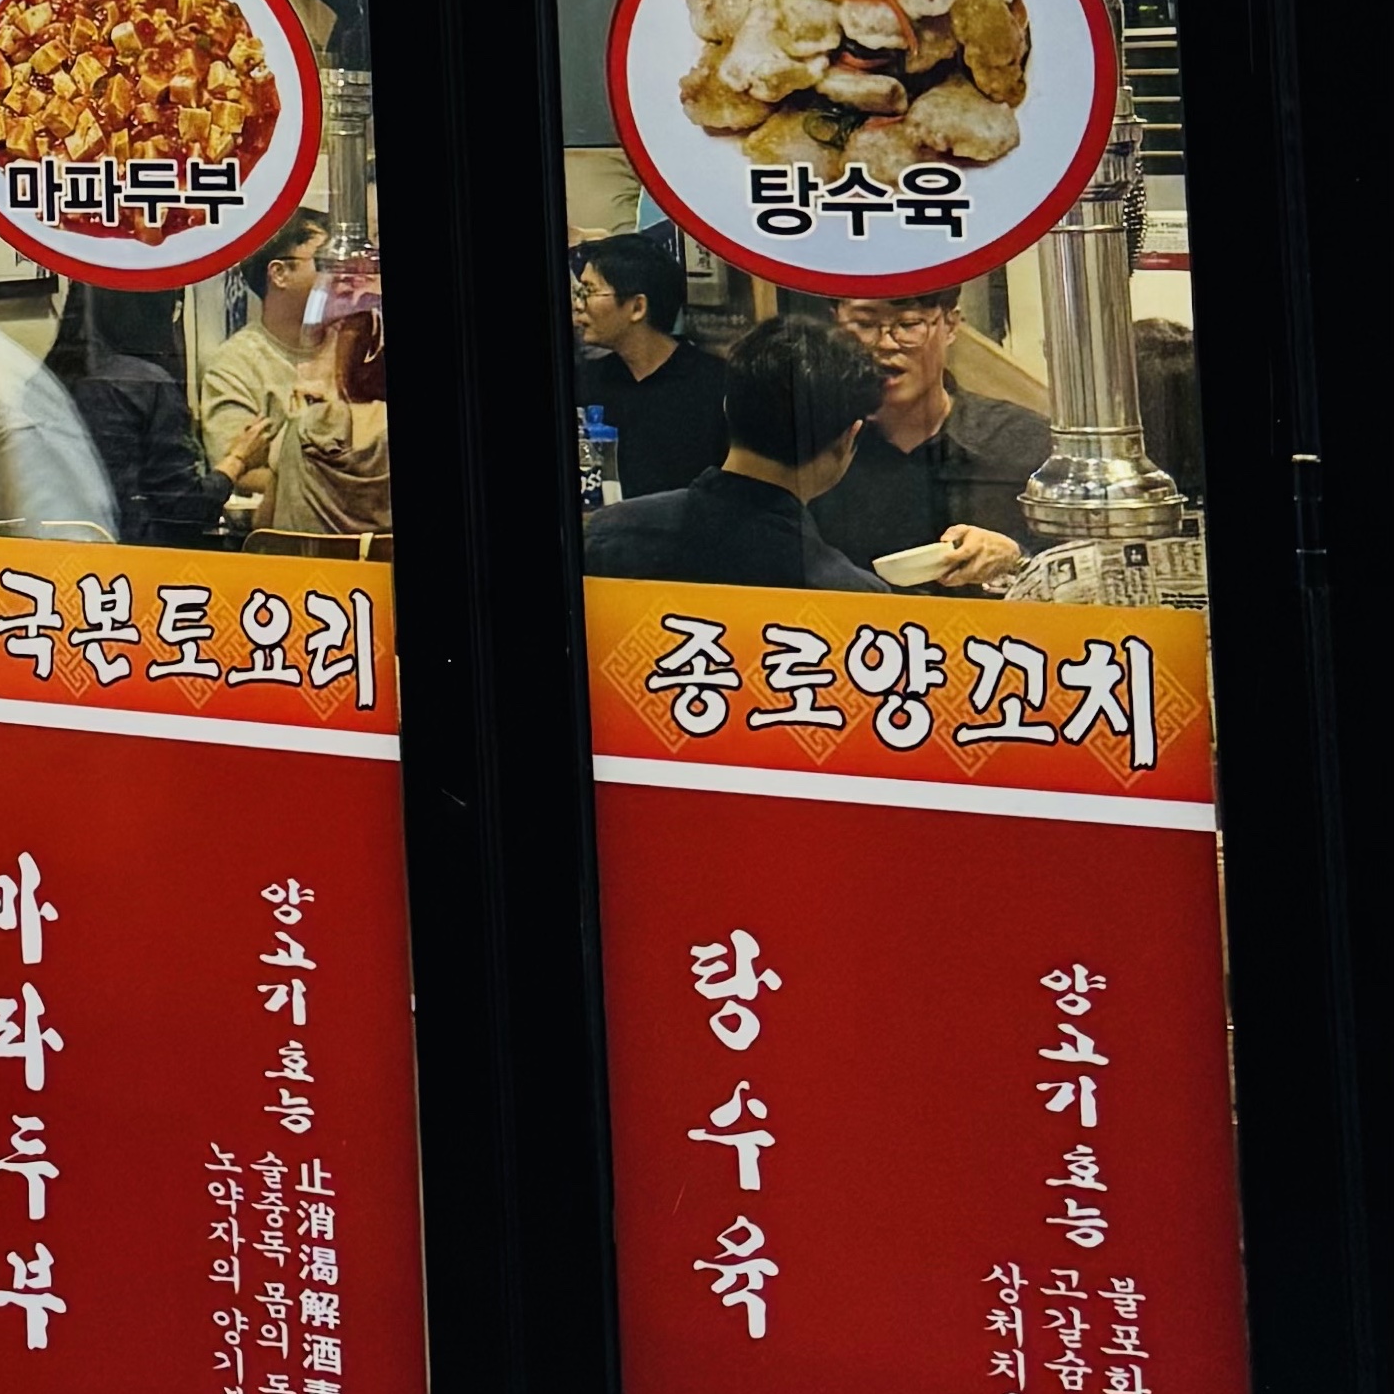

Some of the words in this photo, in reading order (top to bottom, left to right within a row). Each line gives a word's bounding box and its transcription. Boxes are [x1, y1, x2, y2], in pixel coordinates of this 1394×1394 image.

[9, 160, 245, 226] 마파두부
[751, 165, 970, 238] 탕수육
[647, 613, 1156, 770] 종로양꼬치
[257, 878, 317, 1025] 양고기
[264, 1041, 315, 1134] 효능
[1036, 962, 1110, 1128] 양고기
[688, 929, 783, 1340] 탕수육
[205, 1142, 246, 1294] 노약자의
[250, 1150, 292, 1267] 술중독
[1045, 1142, 1110, 1250] 효능
[255, 1281, 293, 1360] 몸의
